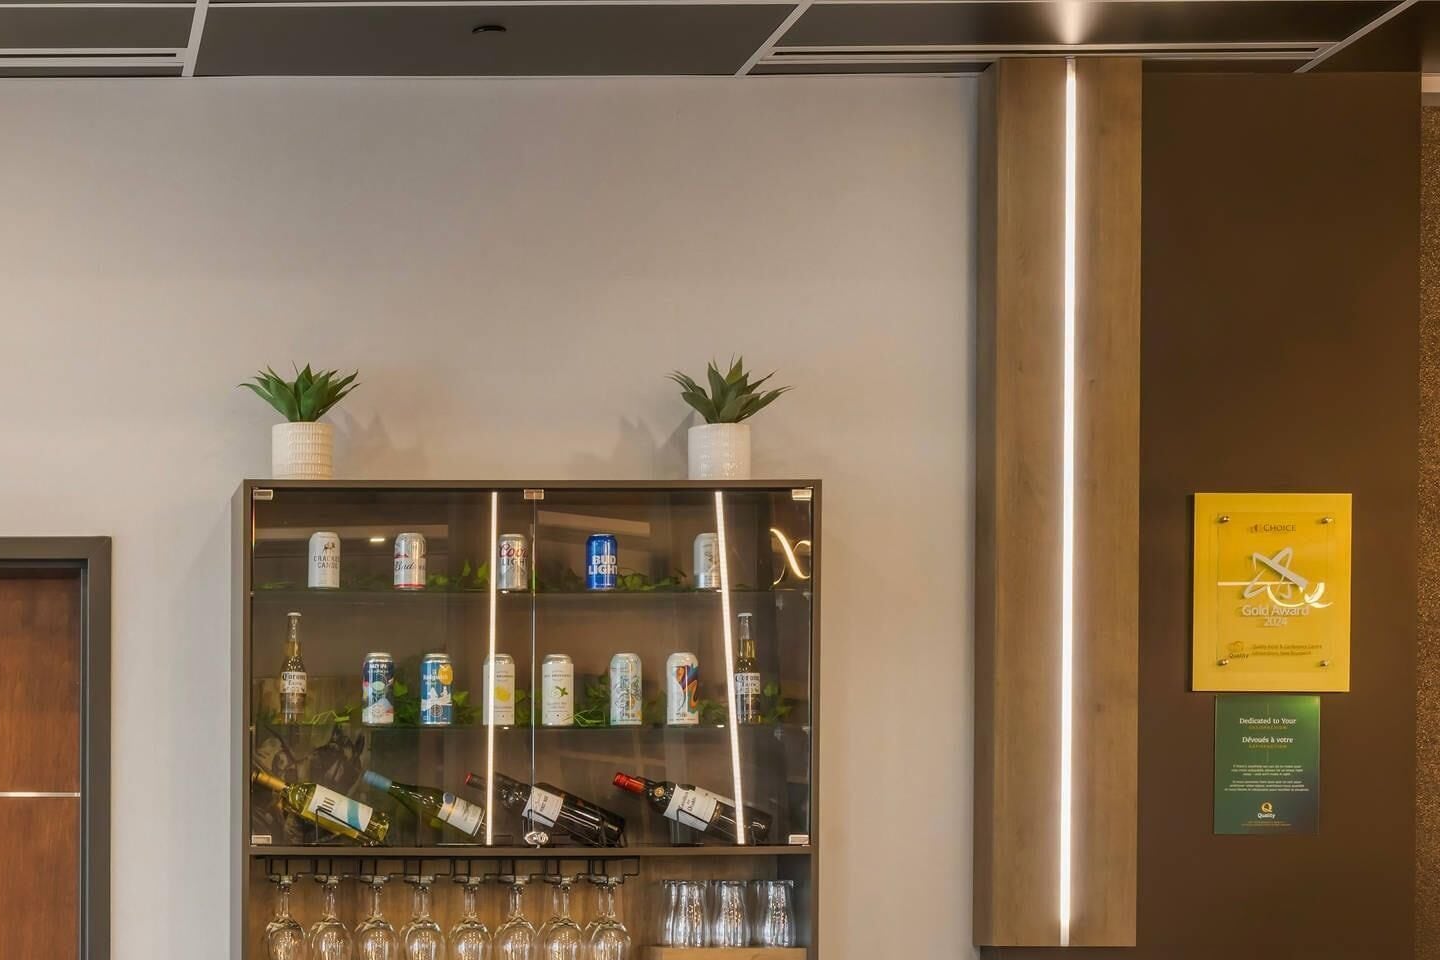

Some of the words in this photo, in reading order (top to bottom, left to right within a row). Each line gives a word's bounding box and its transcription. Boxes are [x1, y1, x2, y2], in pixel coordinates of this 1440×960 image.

[1263, 524, 1297, 532] CHOICE
[591, 555, 616, 565] BUD
[1242, 604, 1269, 616] Gold
[1271, 604, 1310, 616] Award
